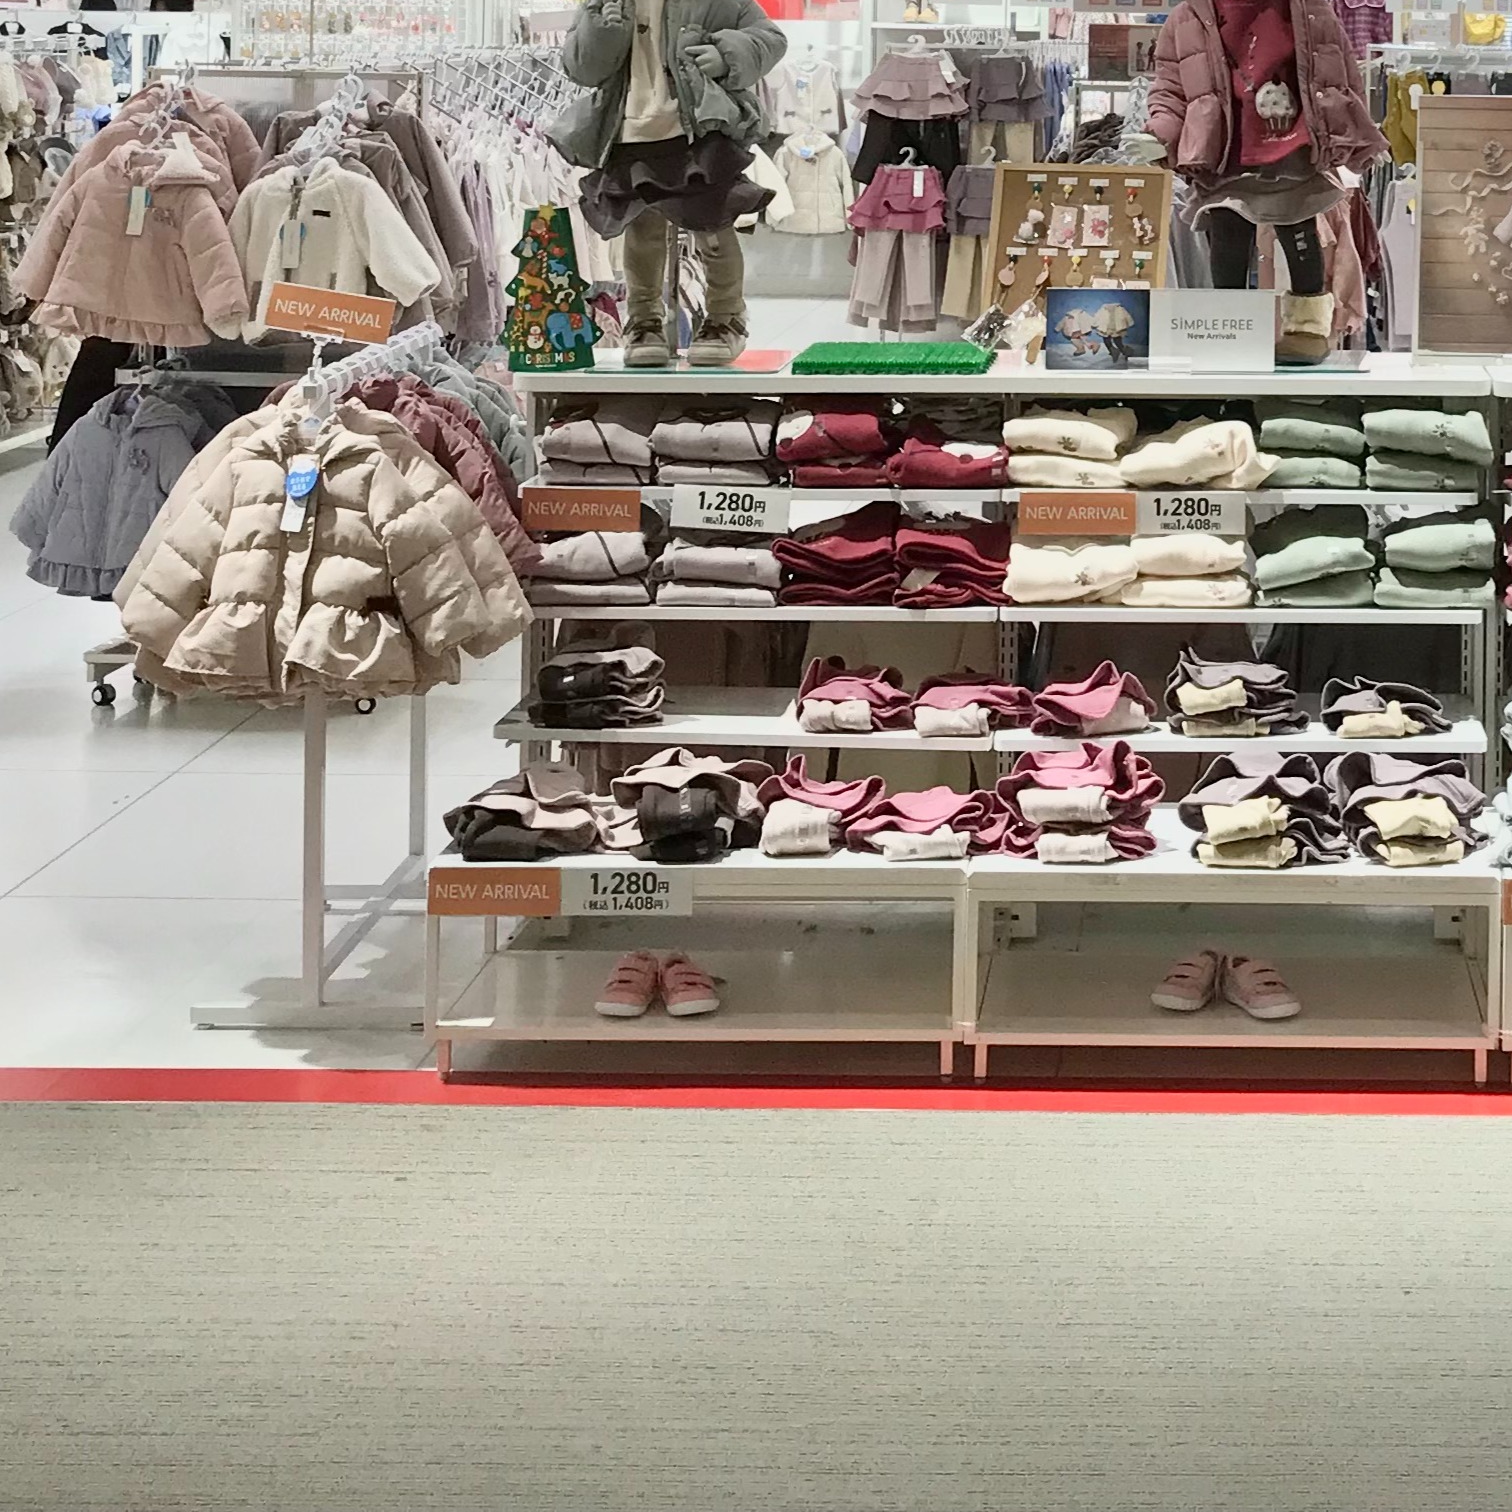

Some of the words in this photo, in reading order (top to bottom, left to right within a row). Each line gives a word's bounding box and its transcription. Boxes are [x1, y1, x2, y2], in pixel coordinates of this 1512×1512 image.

[275, 298, 316, 317] NEW
[318, 306, 382, 328] ARRIVAL
[1222, 319, 1254, 331] FREE
[1187, 332, 1205, 340] New
[1206, 332, 1237, 340] Arrivals
[528, 501, 566, 516] NEW
[569, 502, 632, 518] ARRIVAL
[697, 491, 766, 514] 1,280円
[1153, 497, 1222, 517] 1,280円
[1025, 506, 1063, 520] NEW
[1066, 506, 1129, 521] ARRIVAL
[434, 884, 477, 900] NEW
[481, 884, 550, 900] ARRIVAL
[589, 872, 670, 896] 1,280円
